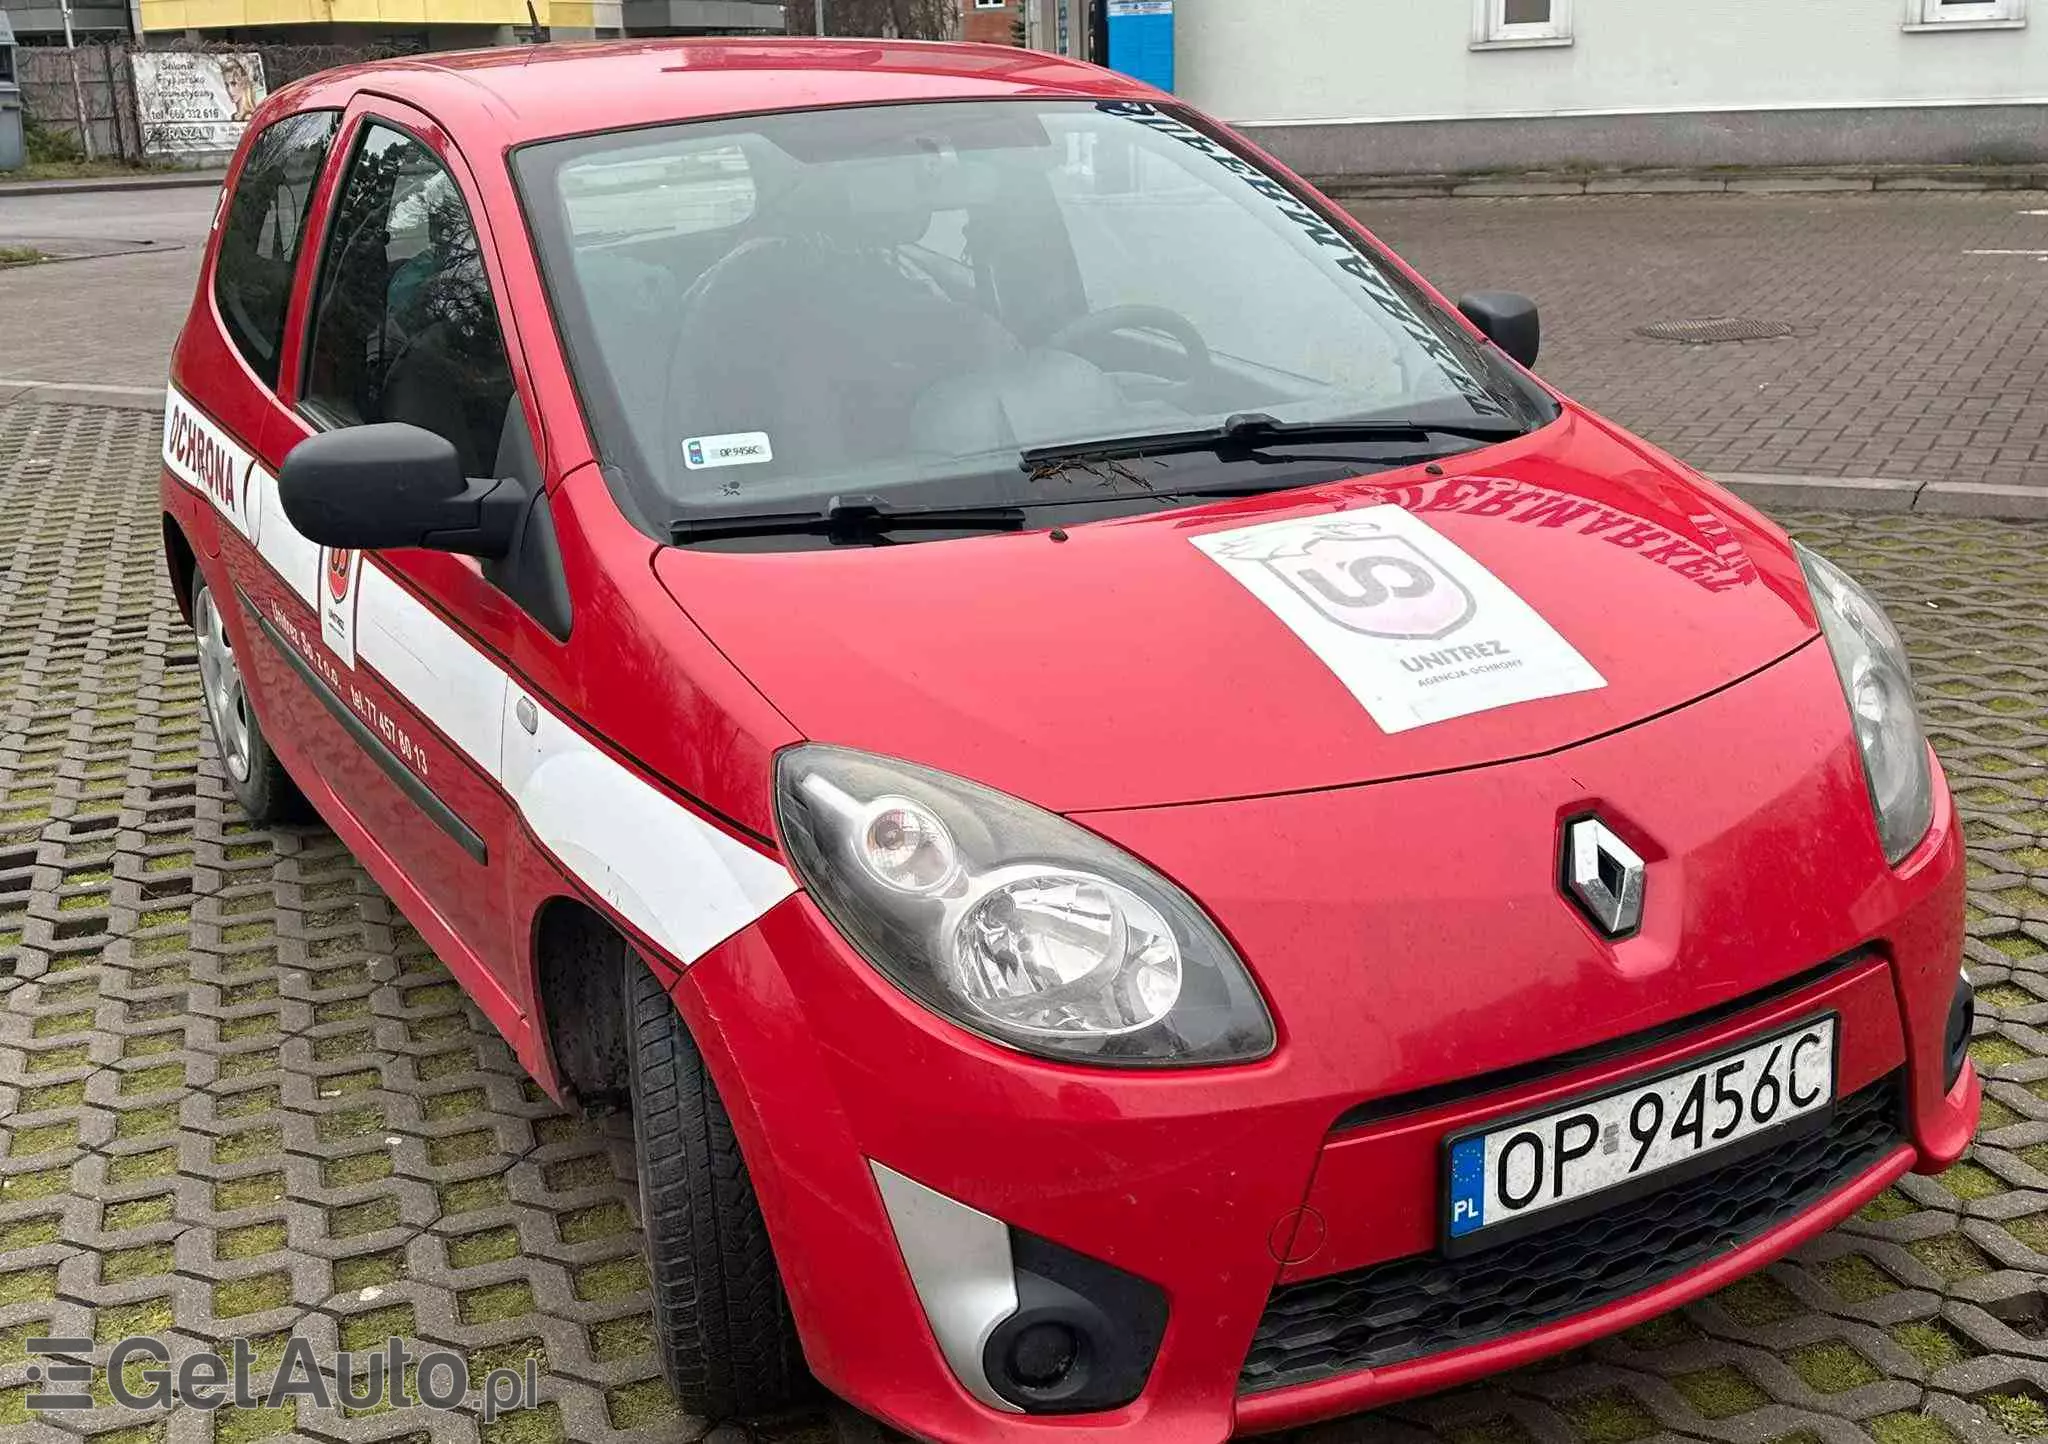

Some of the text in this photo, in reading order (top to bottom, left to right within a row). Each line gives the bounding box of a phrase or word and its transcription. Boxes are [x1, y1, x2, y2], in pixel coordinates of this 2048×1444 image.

[169, 404, 236, 512] OCHRONA
[1399, 639, 1512, 673] UNITREZ
[1418, 659, 1523, 687] AGENCJA OCHRONY
[379, 711, 396, 745] 457
[1498, 1032, 1820, 1210] OP 9456C
[1454, 1197, 1479, 1223] PL
